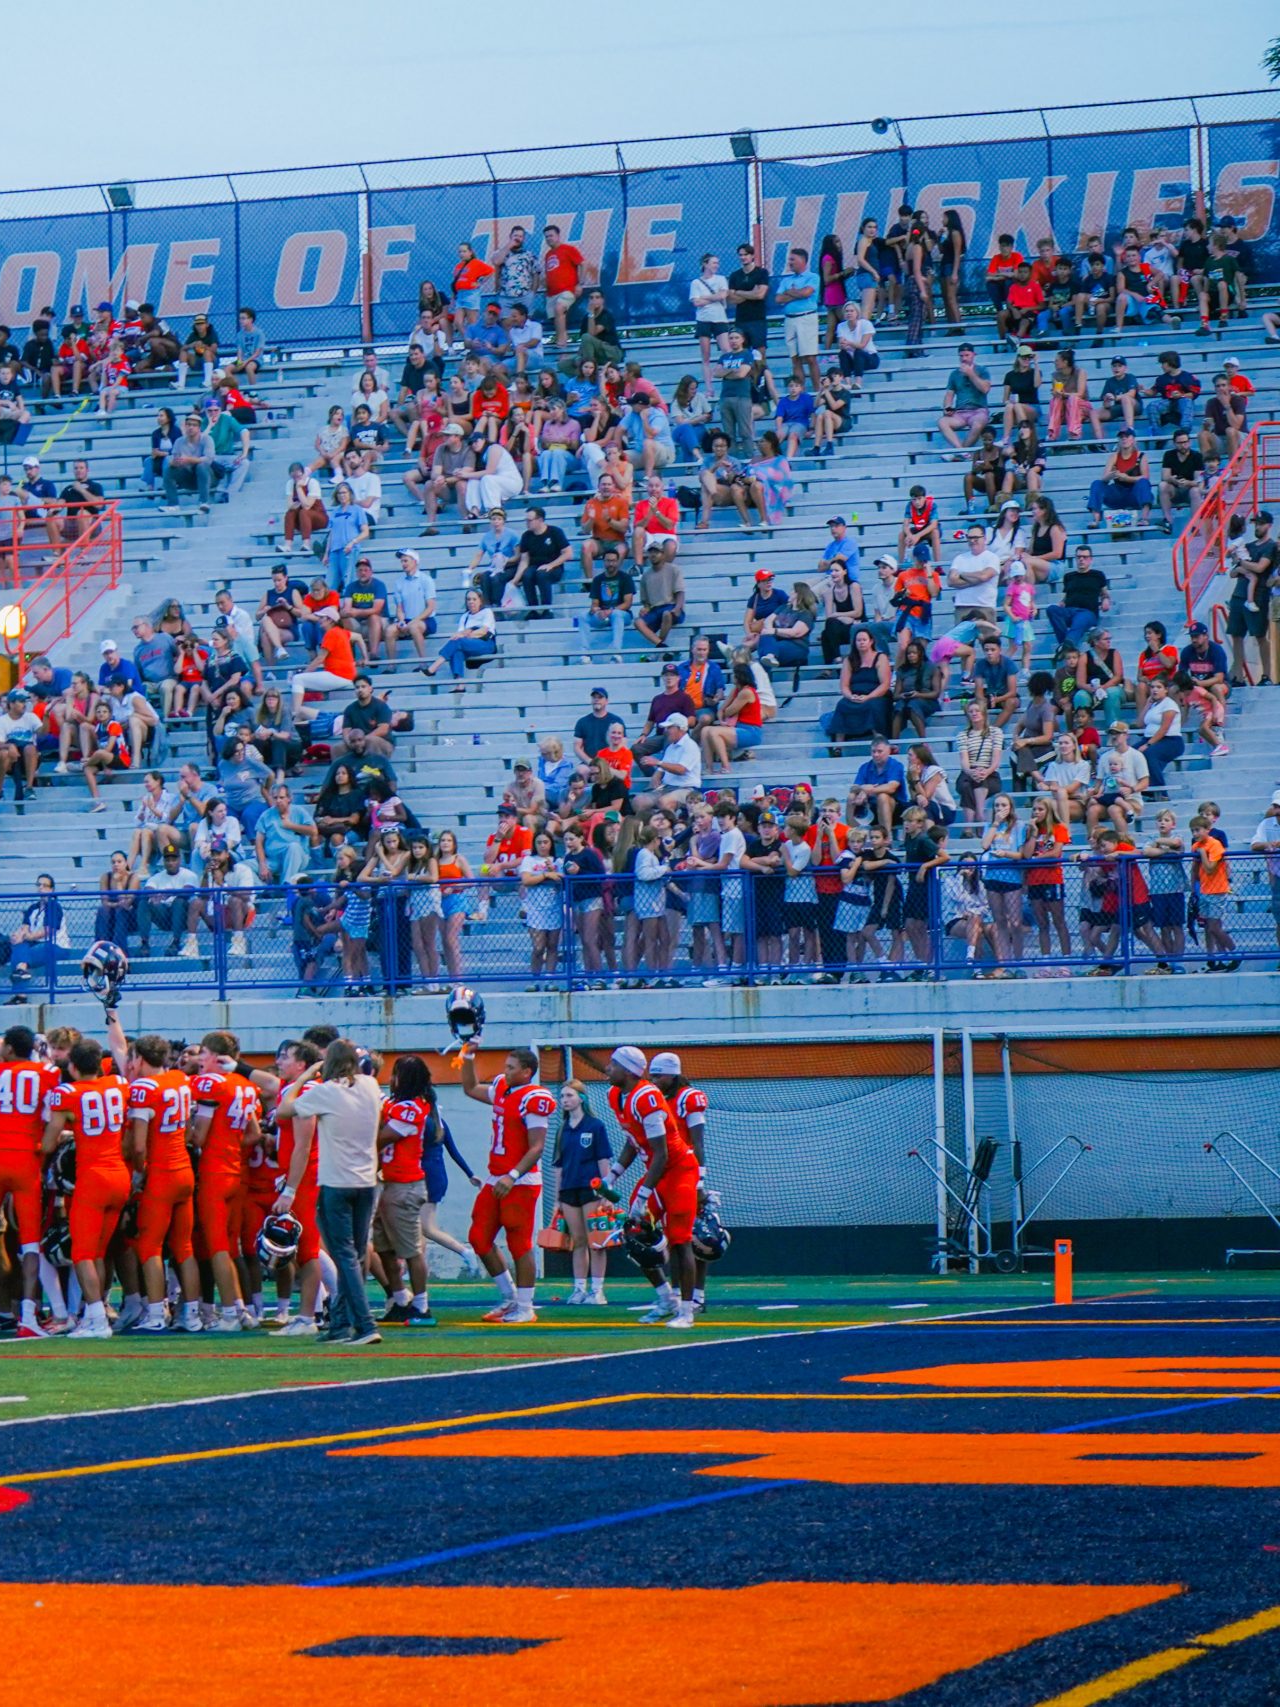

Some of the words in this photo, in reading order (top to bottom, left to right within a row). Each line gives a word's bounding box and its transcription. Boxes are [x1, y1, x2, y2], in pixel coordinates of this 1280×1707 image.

[274, 224, 416, 309] OF
[470, 203, 683, 298] THE
[198, 1079, 213, 1093] 42
[131, 1089, 146, 1103] 20
[648, 1094, 658, 1108] 0
[81, 1087, 123, 1136] 88
[160, 1085, 191, 1132] 20
[538, 1099, 550, 1113] 51
[400, 1109, 416, 1122] 48
